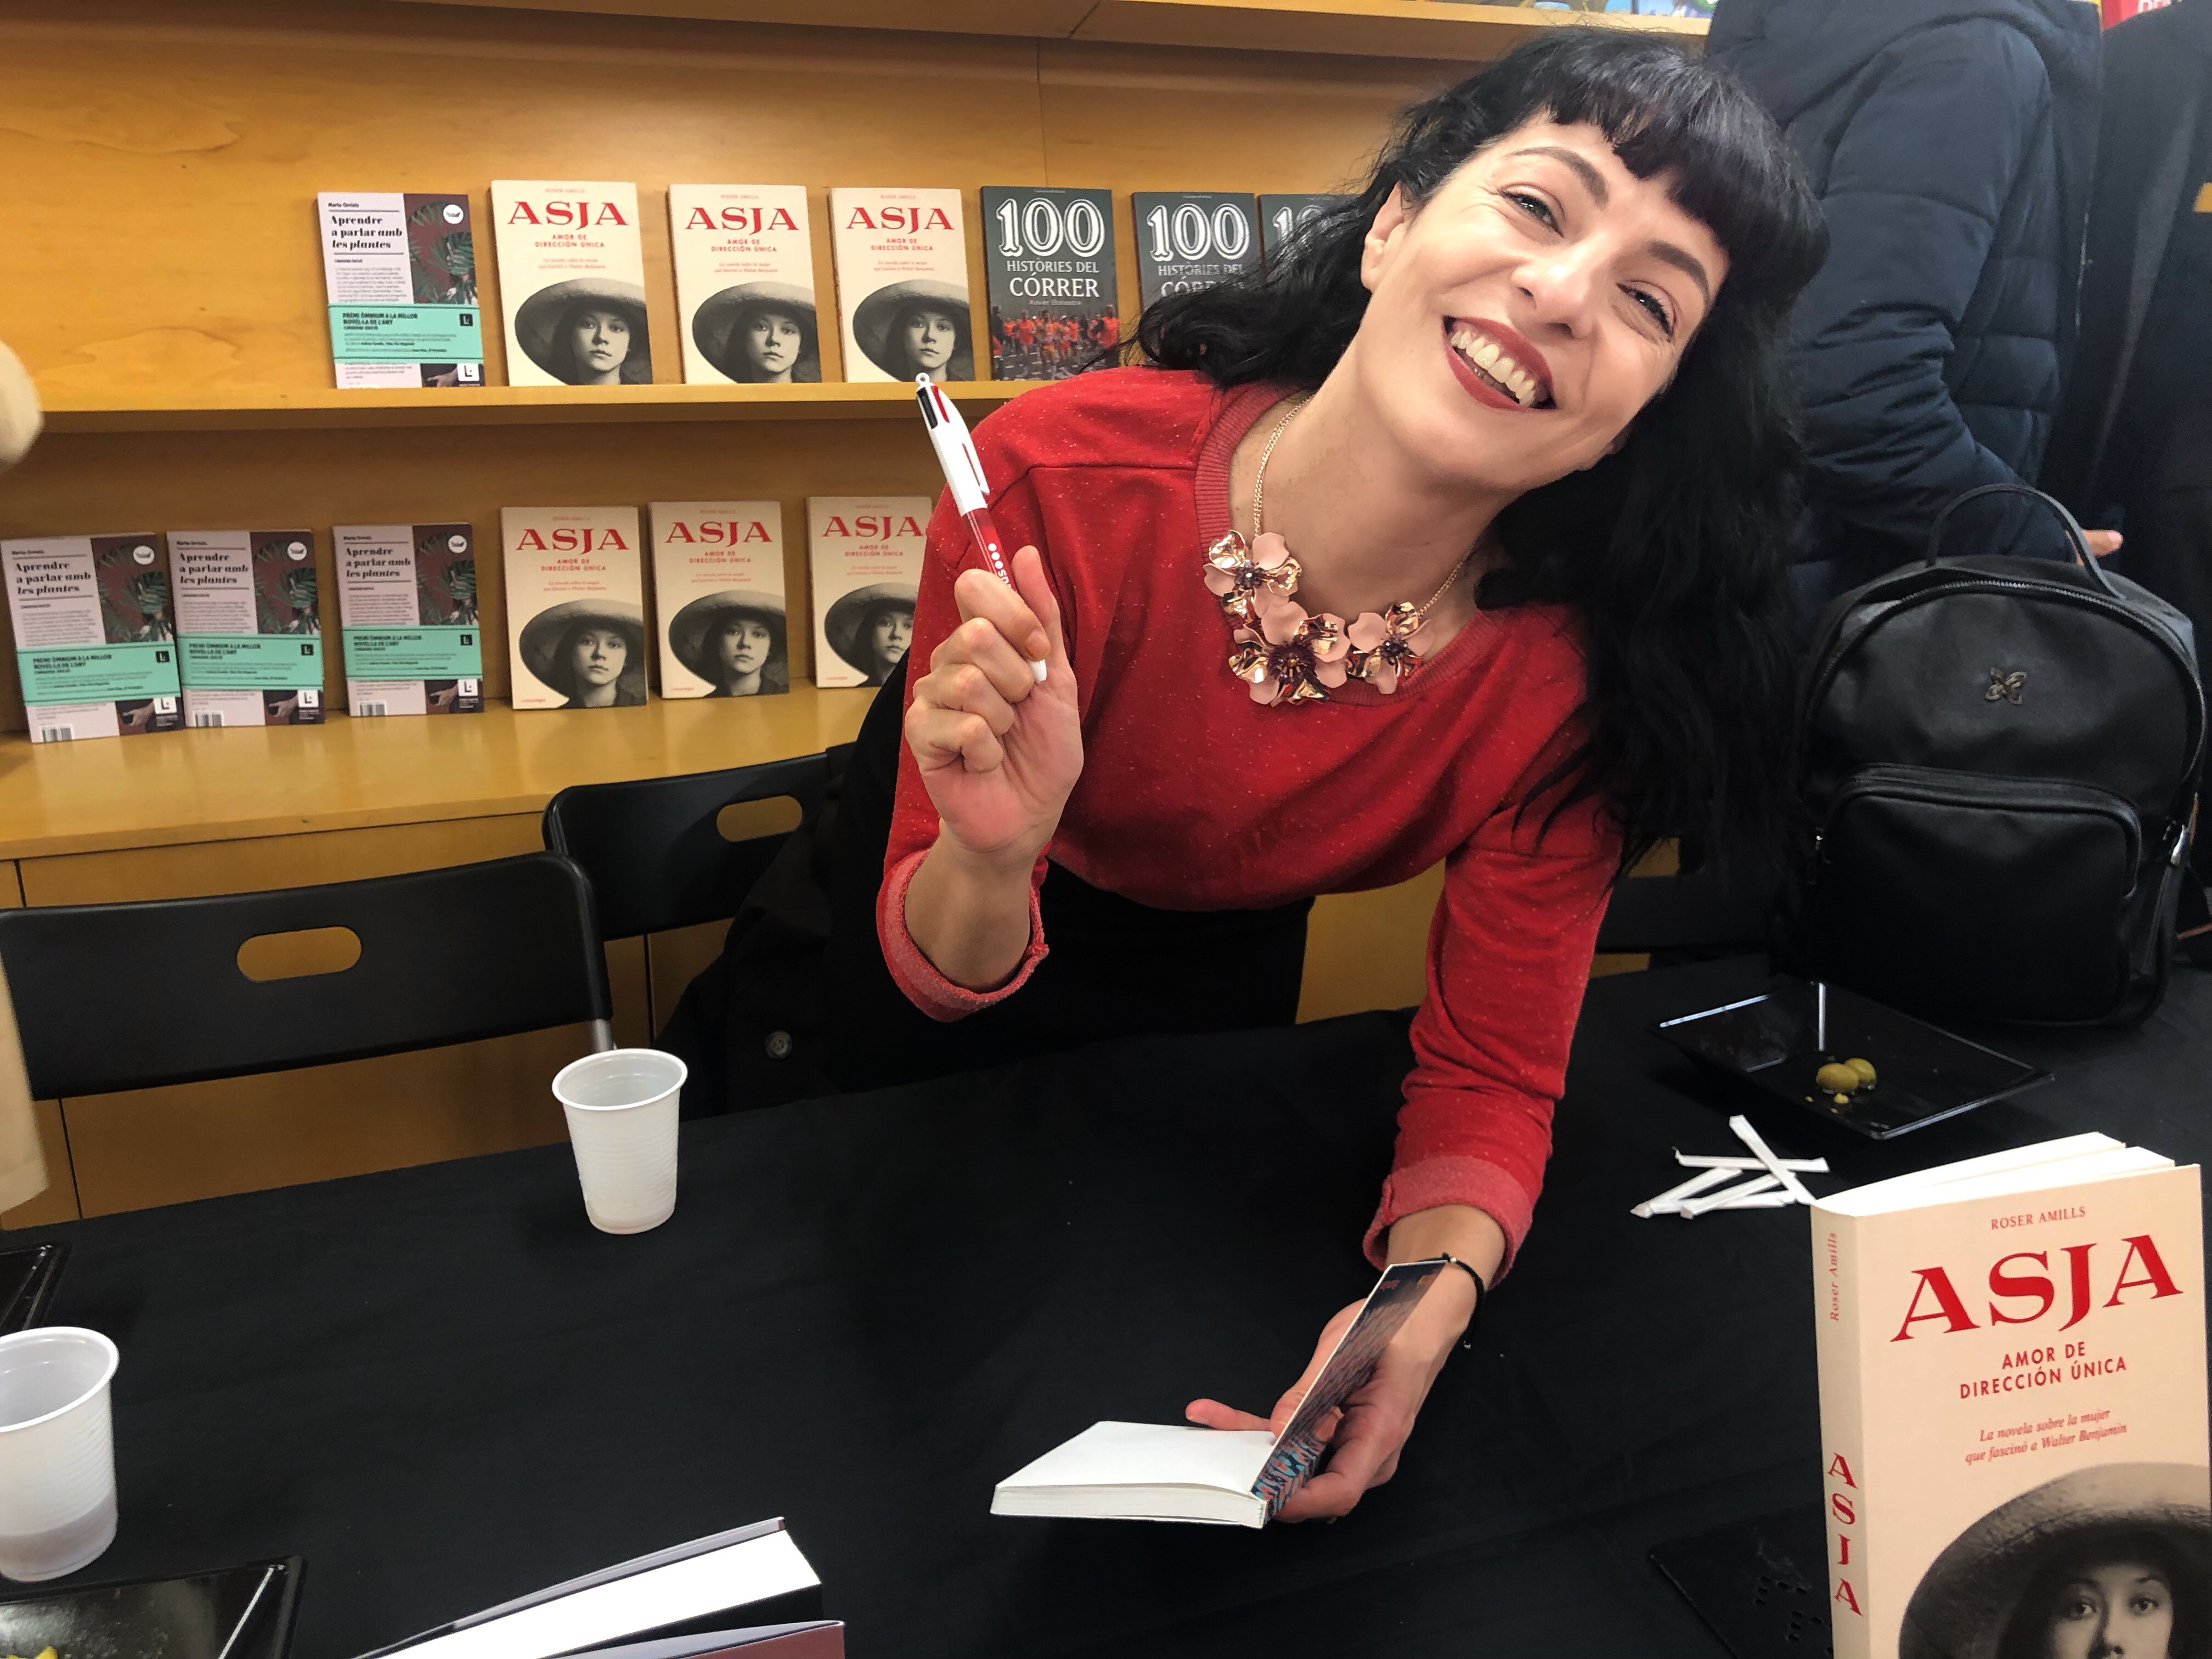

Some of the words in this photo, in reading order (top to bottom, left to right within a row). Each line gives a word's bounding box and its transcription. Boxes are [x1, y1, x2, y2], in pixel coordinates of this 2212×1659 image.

[331, 216, 382, 226] Aprendre
[507, 201, 629, 230] ASJA
[685, 207, 799, 235] ASJA
[846, 207, 955, 234] ASJA
[996, 198, 1105, 257] 100
[341, 228, 376, 238] parlar
[378, 228, 403, 236] amb
[1147, 203, 1250, 262] 100
[332, 240, 347, 248] les
[349, 240, 391, 251] plantes
[1007, 257, 1073, 272] HISTÒRIES
[1076, 262, 1100, 273] DEL
[1009, 272, 1100, 297] CÓRRER
[664, 521, 772, 548] ASJA
[822, 516, 924, 541] ASJA
[346, 547, 393, 557] Aprendre
[515, 528, 630, 555] ASJA
[15, 561, 70, 573] Aprendre
[179, 552, 229, 562] Aprendre
[188, 565, 224, 574] parlar
[354, 558, 386, 569] parlar
[388, 558, 411, 566] amb
[26, 573, 61, 585] parlar
[65, 571, 91, 580] amb
[180, 576, 195, 584] les
[198, 576, 237, 586] plantes
[346, 569, 360, 578] les
[362, 569, 400, 579] plantes
[18, 586, 33, 595] les
[37, 585, 80, 596] plantes
[1991, 1214, 2034, 1230] ROSER
[2038, 1206, 2086, 1223] AMILLS
[1827, 1233, 1838, 1277] Amills
[1890, 1234, 2184, 1342] ASJA
[1830, 1282, 1839, 1321] Roser
[2002, 1347, 2055, 1369] AMOR
[2064, 1341, 2085, 1358] DE
[1960, 1366, 2062, 1399] DIRECCIÓN
[2070, 1356, 2127, 1380] ÚNICA
[1979, 1429, 1994, 1442] La
[1997, 1422, 2033, 1438] novela
[2036, 1418, 2065, 1431] sobre
[2067, 1413, 2077, 1425] la
[2080, 1409, 2111, 1424] mujer
[1965, 1452, 1987, 1465] que
[1988, 1441, 2028, 1462] fascinó
[2030, 1442, 2038, 1451] a
[2041, 1434, 2075, 1448] Walter
